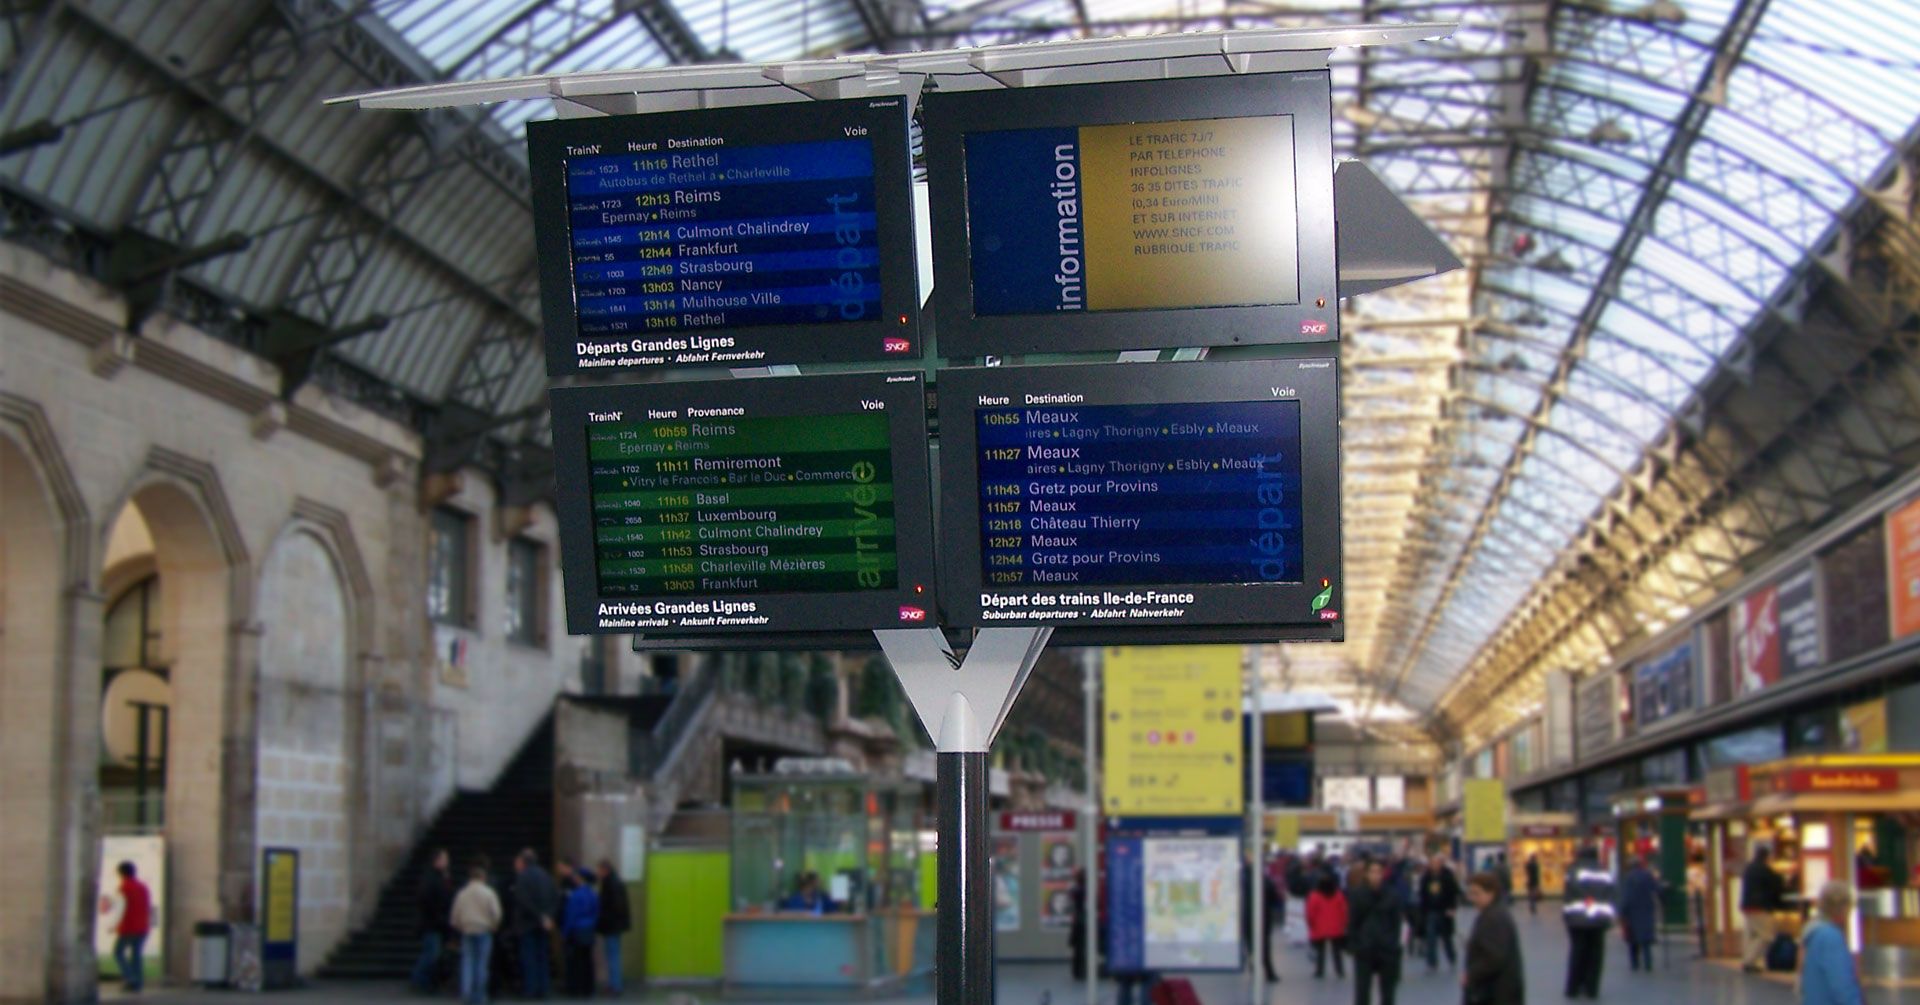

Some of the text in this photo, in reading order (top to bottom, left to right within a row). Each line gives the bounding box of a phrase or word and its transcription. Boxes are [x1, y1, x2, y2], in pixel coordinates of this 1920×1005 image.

[628, 142, 657, 151] Heure
[668, 137, 724, 148] Destination
[844, 126, 867, 136] Voie
[1129, 134, 1187, 145] LE TRAFIC
[1130, 147, 1225, 161] PAR TELEPHONE
[633, 159, 668, 171] 11h16
[672, 153, 719, 168] Rethel
[600, 165, 791, 188] Autobus de Rethel Charleville
[1131, 165, 1201, 177] INFOLIGNES
[1131, 184, 1144, 193] 36
[1149, 183, 1161, 192] 35
[1164, 181, 1198, 191] DITES
[602, 200, 621, 209] 1723
[636, 194, 670, 206] 12h13
[675, 190, 721, 204] Reims
[602, 208, 697, 225] Epernay Reims
[1133, 209, 1237, 224] ET SUR INTERNET
[639, 231, 670, 241] 12h14
[677, 226, 733, 239] Culmont
[737, 221, 810, 239] Chalindrey
[1050, 144, 1082, 310] information
[640, 248, 672, 259] 12h44
[678, 242, 738, 257] Frankfurt
[1135, 241, 1240, 255] RUBRIQUE TRAFIC
[826, 192, 871, 320] départ
[641, 266, 673, 276] 12h49
[680, 260, 753, 274] Strasbourg
[642, 283, 674, 293] 13h03
[681, 279, 722, 291] Nancy
[644, 293, 781, 311] 13h14 Mulhouse Ville
[645, 313, 724, 328] 13h16 Rethel
[577, 336, 734, 356] Départs Grandes Lignes
[885, 343, 908, 351] SNCF
[579, 351, 765, 368] Mainline departures Abfahrt Fernverkehr
[979, 387, 1295, 405] Heure Destination Voie
[648, 410, 677, 419] Heure
[688, 407, 744, 417] Provenance
[861, 400, 884, 410] Voie
[984, 410, 1078, 425] 10h55 Meaux
[653, 427, 688, 437] 10h59
[692, 424, 736, 436] Reims
[1062, 422, 1259, 439] Lagny Thorigny Esbly Meaux
[620, 441, 710, 455] Epernay Reims
[985, 445, 1080, 460] 11h27 Meaux
[656, 461, 688, 472] 11h11
[694, 456, 781, 470] Remiremont
[1028, 458, 1264, 475] aires Lagny Thorigny Esbly Meaux
[630, 477, 656, 488] Vitry
[659, 476, 668, 485] le
[729, 474, 748, 483] Bar
[751, 473, 760, 482] le
[764, 472, 785, 481] Duc
[987, 480, 1158, 495] 11h43 Gretz pour Provins
[658, 493, 729, 506] 11h16 Basel
[988, 500, 1076, 513] 11h57 Meaux
[659, 510, 776, 523] 11h37 Luxembourg
[989, 517, 1140, 530] 12h18 Château Thierry
[1250, 452, 1291, 580] départ
[846, 461, 881, 588] arrivée
[660, 525, 823, 540] 11h42 Culmont Chalindrey
[989, 535, 1077, 547] 12h27 Meaux
[662, 547, 692, 557] 11h53
[700, 543, 768, 557] Strasbourg
[701, 560, 766, 573] Charleville
[771, 558, 825, 571] Mézières
[990, 551, 1160, 565] 12h44 Gretz pour Provins
[991, 570, 1078, 582] 12h57 Meaux
[664, 577, 758, 591] 13h03 Frankfurt
[981, 591, 1194, 608] Départ des trains Ile-de-France
[598, 600, 756, 616] Arrivées Grandes Lignes
[900, 611, 923, 619] SNCF
[982, 608, 1184, 620] Suburban departures Abfahrt Nahverkehr
[599, 616, 769, 627] Mainline arrivals Ankunft Fernverkehr
[1012, 814, 1063, 828] PRESSE
